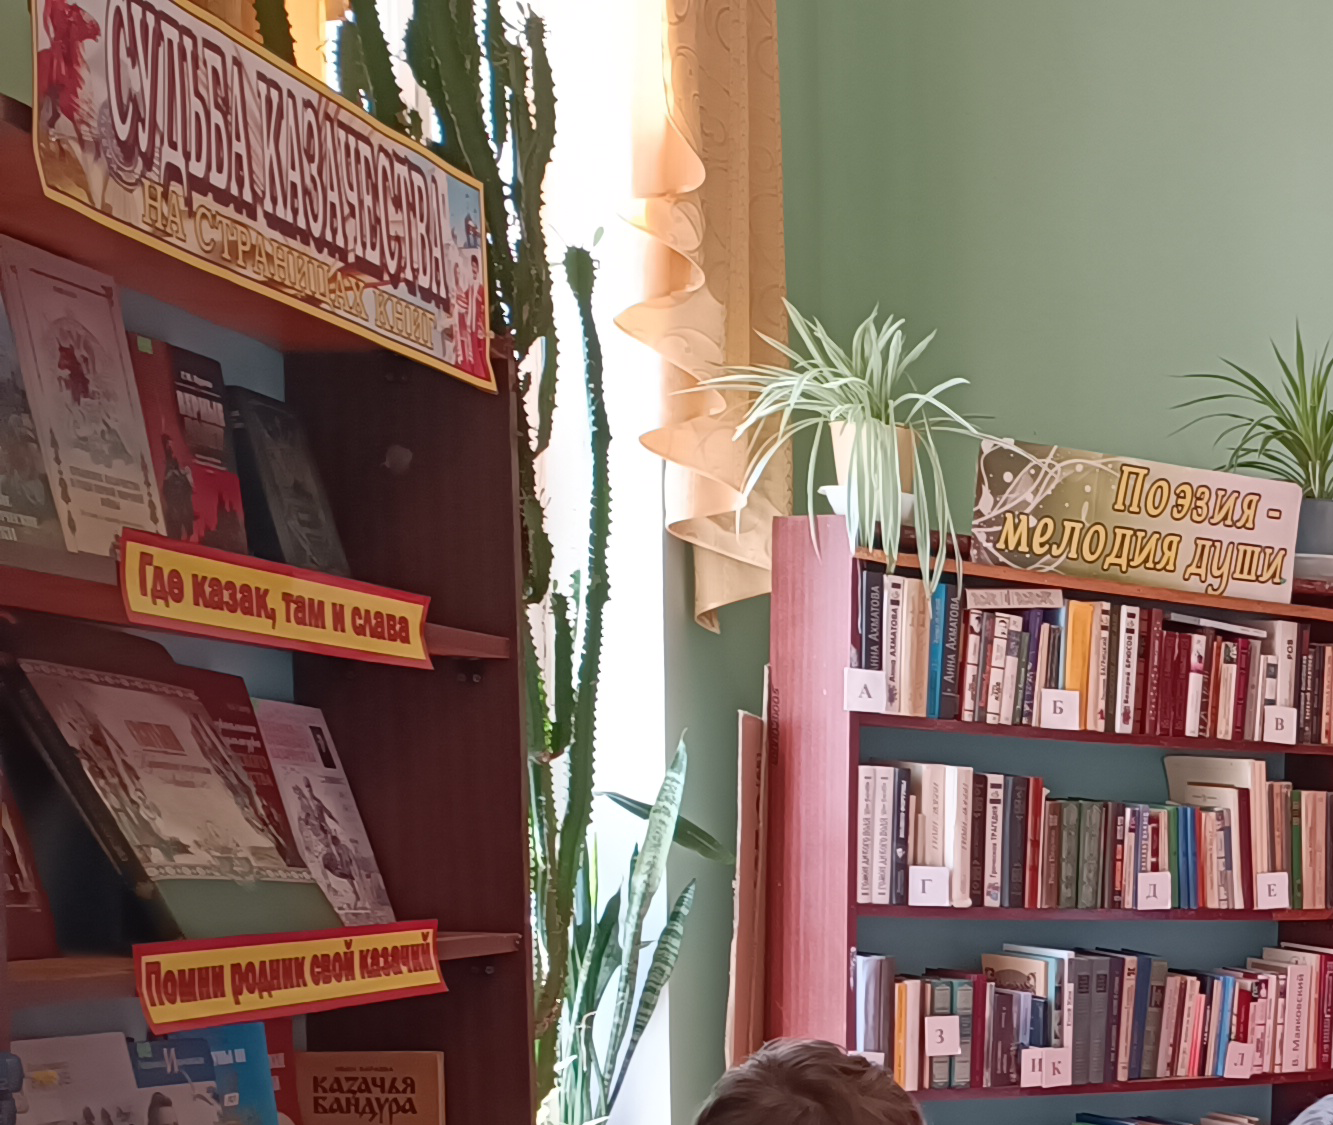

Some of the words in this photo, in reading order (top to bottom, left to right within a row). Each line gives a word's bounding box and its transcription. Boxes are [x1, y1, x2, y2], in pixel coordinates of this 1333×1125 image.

[106, 0, 254, 204] СУДЬБА
[256, 74, 448, 300] КАЗАЧЕСТВА
[142, 180, 188, 244] НА
[194, 206, 370, 322] СТРАНИЦАХ
[372, 290, 436, 350] КНИГ
[1112, 464, 1262, 532] Поэзия
[1266, 508, 1282, 520] -
[996, 512, 1184, 574] мелодия
[1182, 536, 1288, 596] души
[138, 552, 184, 606] Где
[190, 570, 276, 628] казак,
[280, 594, 326, 630] там
[330, 600, 346, 630] и
[350, 608, 412, 646] слава
[868, 584, 882, 642] АХМАТОВА
[890, 606, 898, 656] АХМАТОВА
[858, 684, 872, 698] А
[1052, 700, 1064, 716] Б
[1274, 718, 1286, 730] В
[920, 878, 932, 894] Г
[1146, 882, 1158, 900] Д
[1268, 882, 1278, 898] Е
[144, 956, 228, 1010] Помни
[230, 952, 306, 1004] родник
[310, 938, 354, 986] свой
[358, 932, 434, 982] казачий
[1292, 972, 1304, 1052] Маяковский
[1050, 1060, 1062, 1078] К
[1234, 1052, 1248, 1068] Л
[312, 1074, 416, 1096] КАЗАЧЬЯ
[312, 1096, 418, 1125] БАНДУРА
